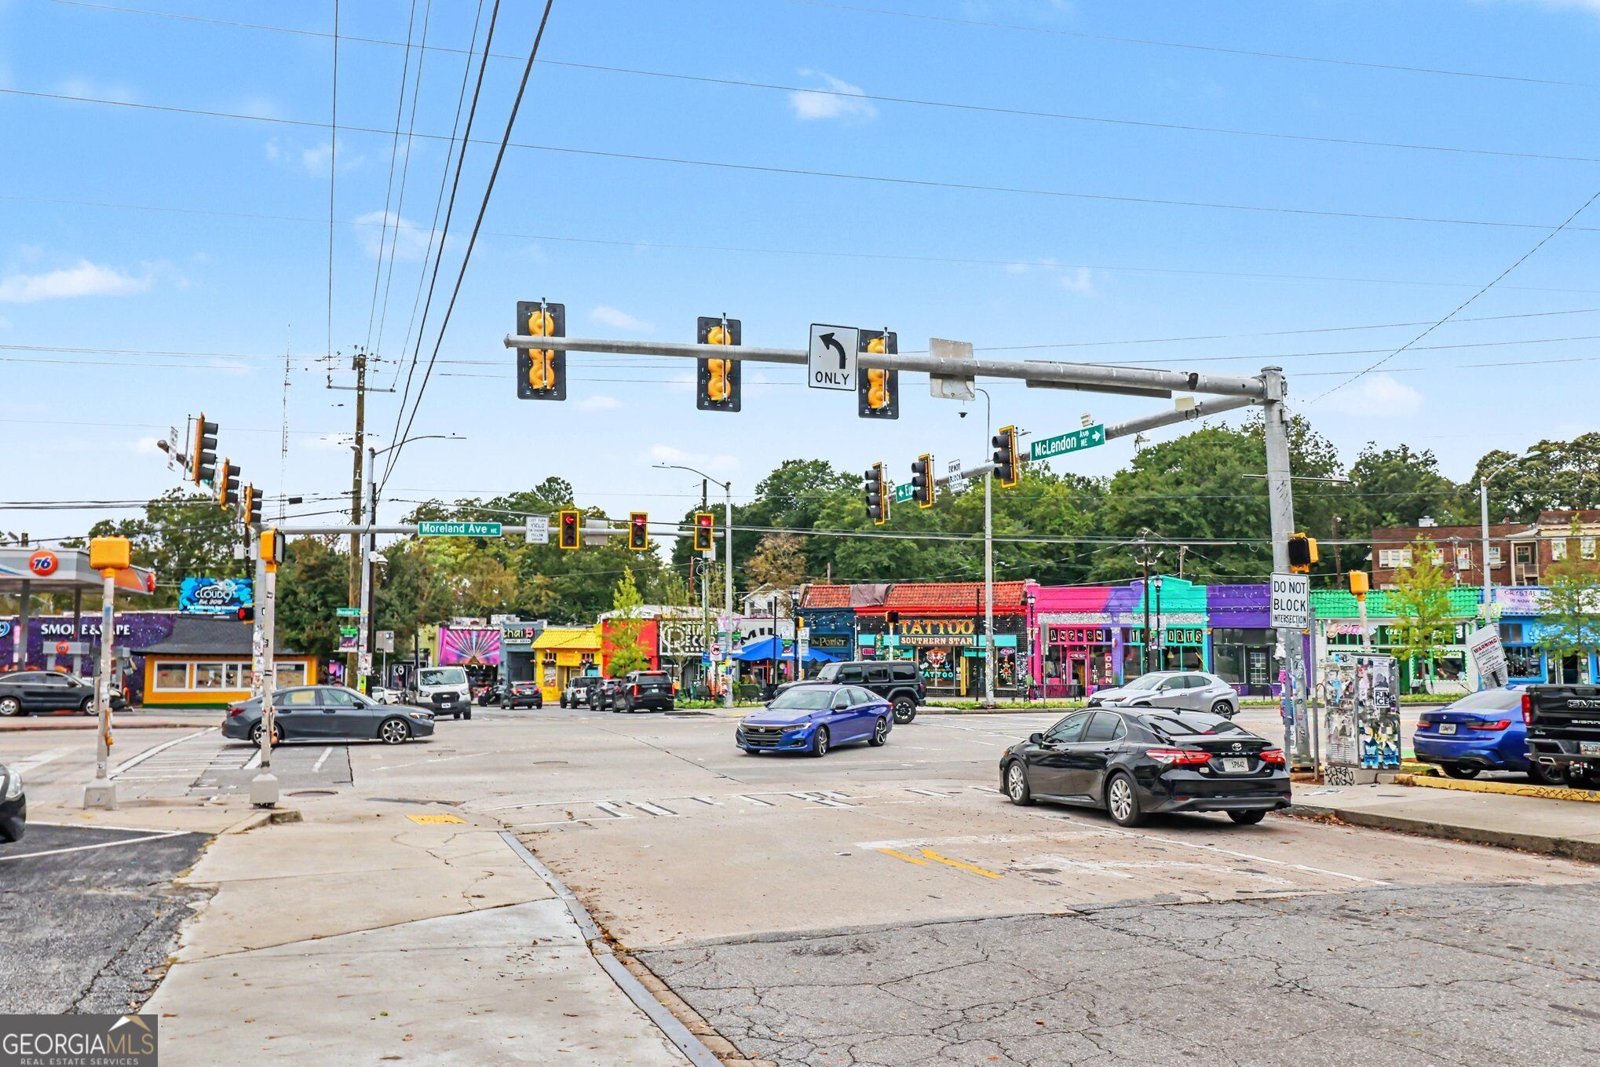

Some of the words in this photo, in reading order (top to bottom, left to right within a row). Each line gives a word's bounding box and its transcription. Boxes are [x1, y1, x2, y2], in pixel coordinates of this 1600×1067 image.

[815, 371, 850, 386] ONLY
[1035, 436, 1077, 457] McLendon
[421, 523, 465, 534] Moreland
[468, 523, 487, 534] Ave
[34, 557, 51, 569] 76
[1273, 580, 1287, 593] DO
[1288, 581, 1306, 594] NOT
[1273, 598, 1306, 612] BLOCK
[1273, 614, 1307, 624] INTERSECTION
[41, 624, 88, 635] SMOE
[503, 627, 524, 638] thai
[898, 620, 975, 635] TATTOO
[819, 636, 846, 647] Porter
[901, 636, 947, 645] SOUTHERN
[948, 636, 974, 645] STAR
[1105, 656, 1113, 684] OPEN
